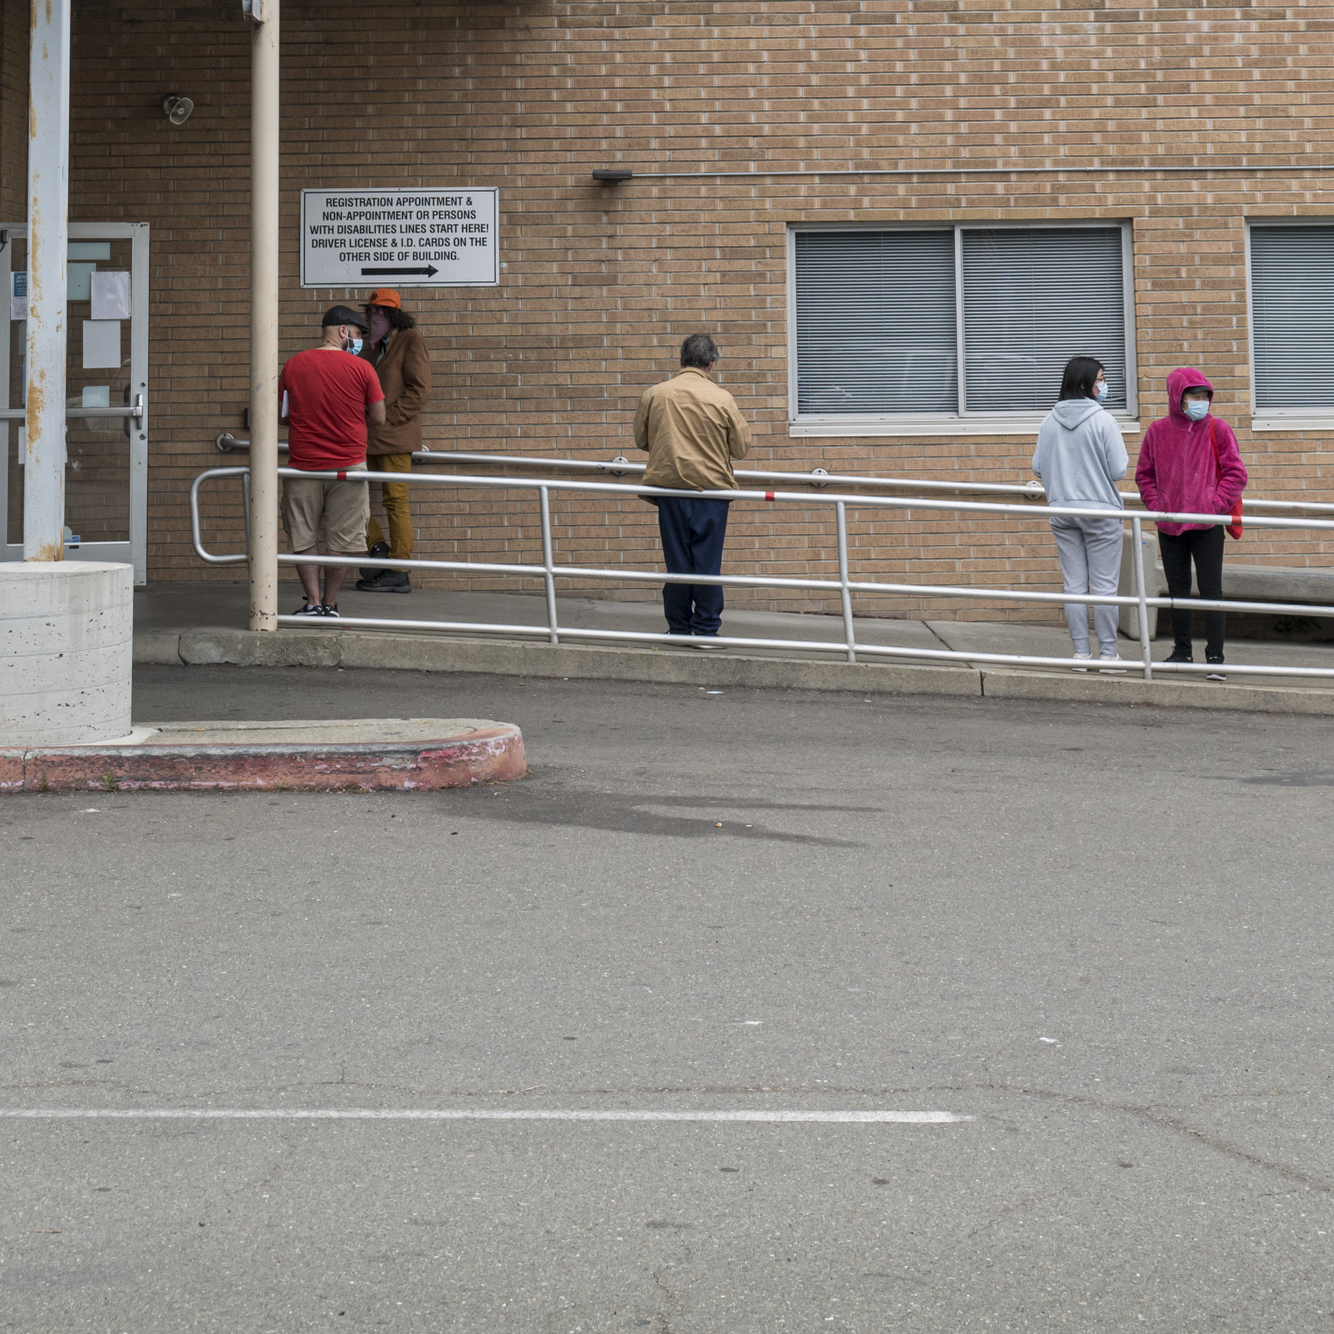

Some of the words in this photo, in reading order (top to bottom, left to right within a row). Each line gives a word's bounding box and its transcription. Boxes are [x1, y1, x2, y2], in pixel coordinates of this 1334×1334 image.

[325, 197, 393, 207] REGISTRATION
[396, 196, 463, 207] APPOINTMENT
[466, 196, 473, 206] &
[322, 211, 414, 221] NON-APPOINTMENT
[416, 210, 430, 220] OR
[432, 210, 477, 220] PERSONS
[309, 225, 334, 234] WITH
[337, 224, 397, 234] DISABILITIES
[400, 223, 427, 233] LINES
[429, 223, 459, 233] START
[461, 223, 489, 233] HERE!
[311, 238, 346, 248] DRIVER
[349, 238, 388, 248] LICENSE
[390, 238, 398, 247] &
[400, 237, 416, 247] I.D.
[418, 237, 451, 247] CARDS
[453, 237, 467, 247] ON
[469, 237, 487, 246] THE
[339, 252, 371, 262] OTHER
[373, 252, 395, 261] SIDE
[397, 251, 410, 261] OF
[412, 251, 460, 261] BUILDING.
